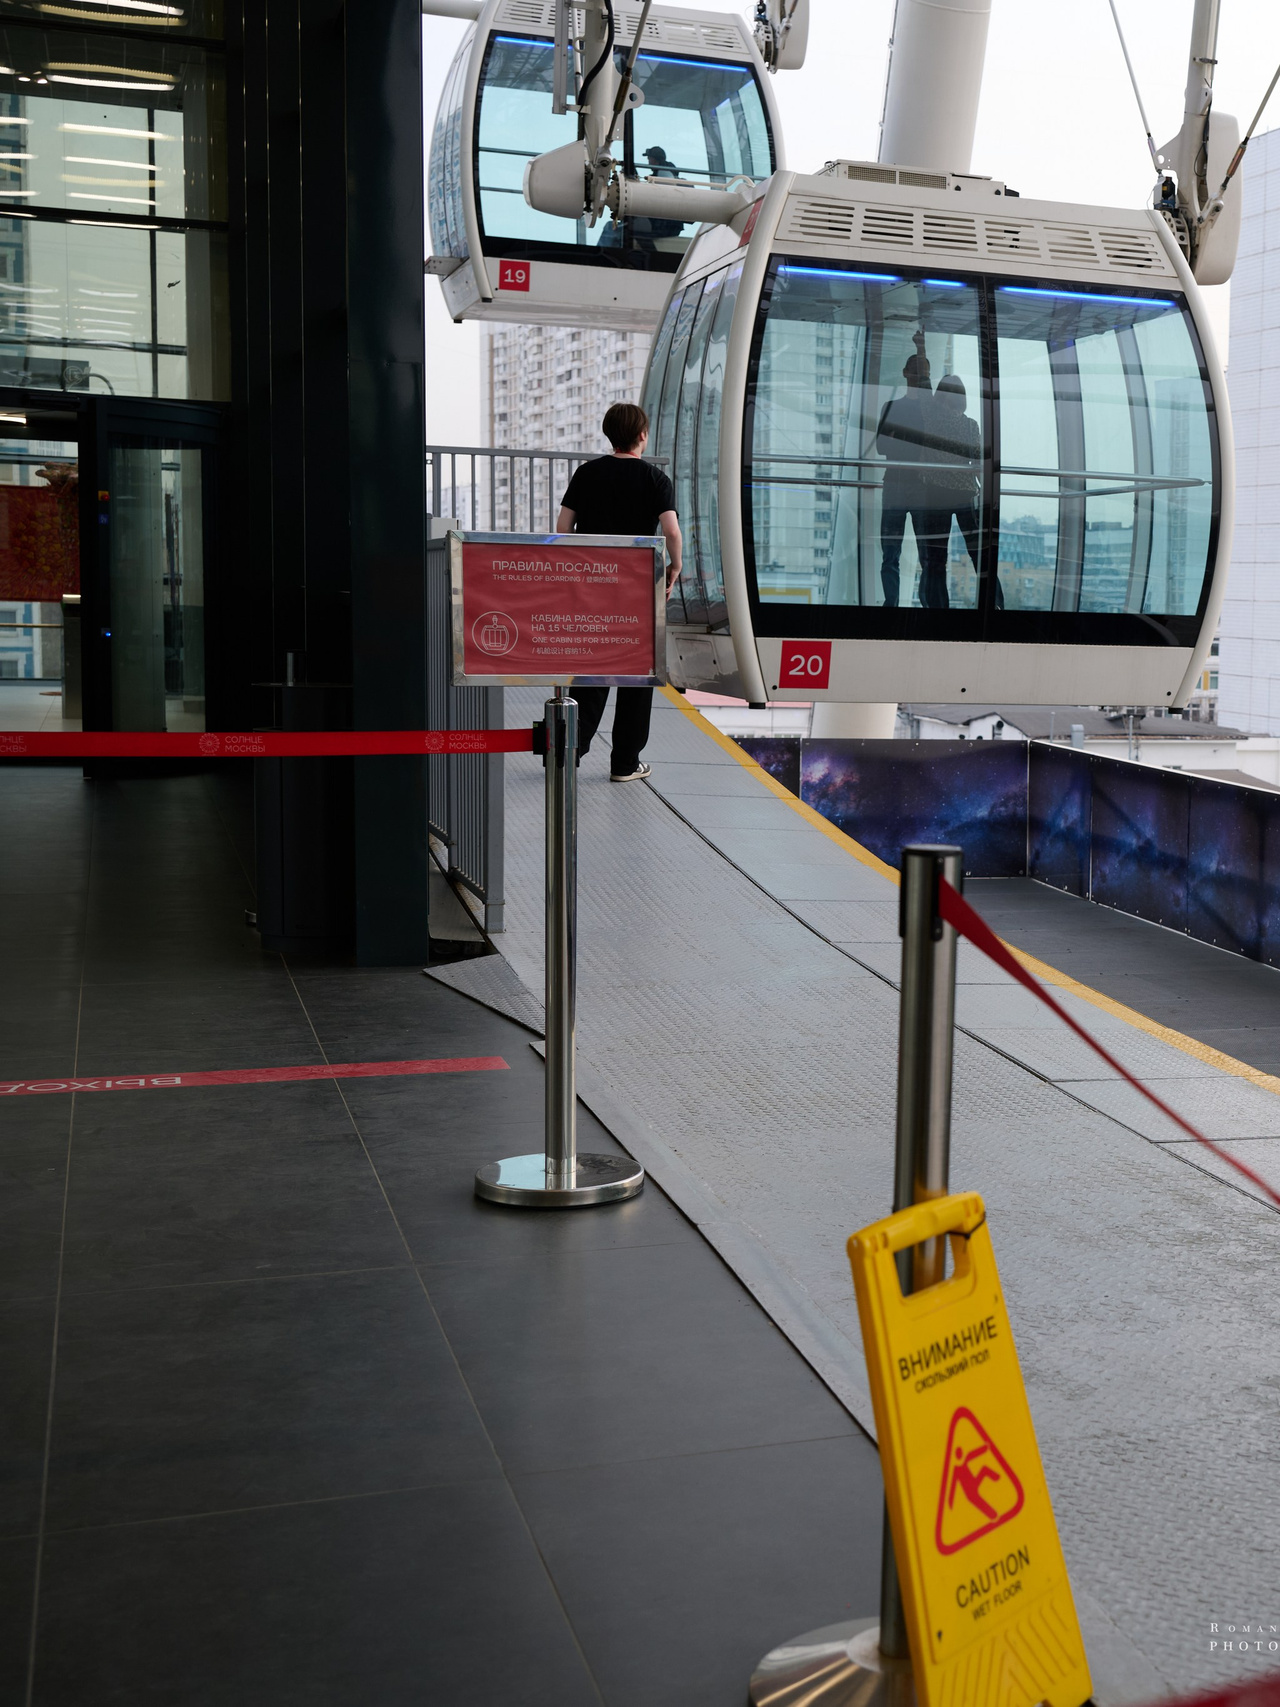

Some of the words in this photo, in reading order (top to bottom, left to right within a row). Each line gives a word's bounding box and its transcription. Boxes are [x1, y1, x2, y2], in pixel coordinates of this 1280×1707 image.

[503, 268, 526, 284] 19
[492, 560, 553, 573] ПРАВИЛА
[555, 562, 618, 575] ПОСАДКИ
[508, 574, 532, 582] RULES
[545, 575, 581, 583] BOARDING
[531, 614, 572, 623] КАБИНА
[574, 615, 639, 624] РАССЧИТАНА
[531, 624, 546, 632] НА
[548, 624, 560, 632] 15
[562, 624, 609, 633] ЧЕЛОВЕК
[549, 636, 573, 644] CABIN
[788, 654, 824, 676] 20
[0, 735, 25, 744] ЛНЦЕ
[224, 735, 263, 744] СОЛНЦЕ
[448, 733, 485, 741] СОЛНЦЕ
[0, 745, 27, 753] СКВЫ
[224, 745, 266, 753] МОСКВЫ
[448, 742, 487, 750] МОСКВЫ
[898, 1315, 998, 1382] ВНИМАНИЕ
[970, 1348, 990, 1367] ПОЛ
[955, 1544, 1030, 1608] CAUTION
[973, 1598, 991, 1621] WET
[992, 1580, 1023, 1608] FLOOR
